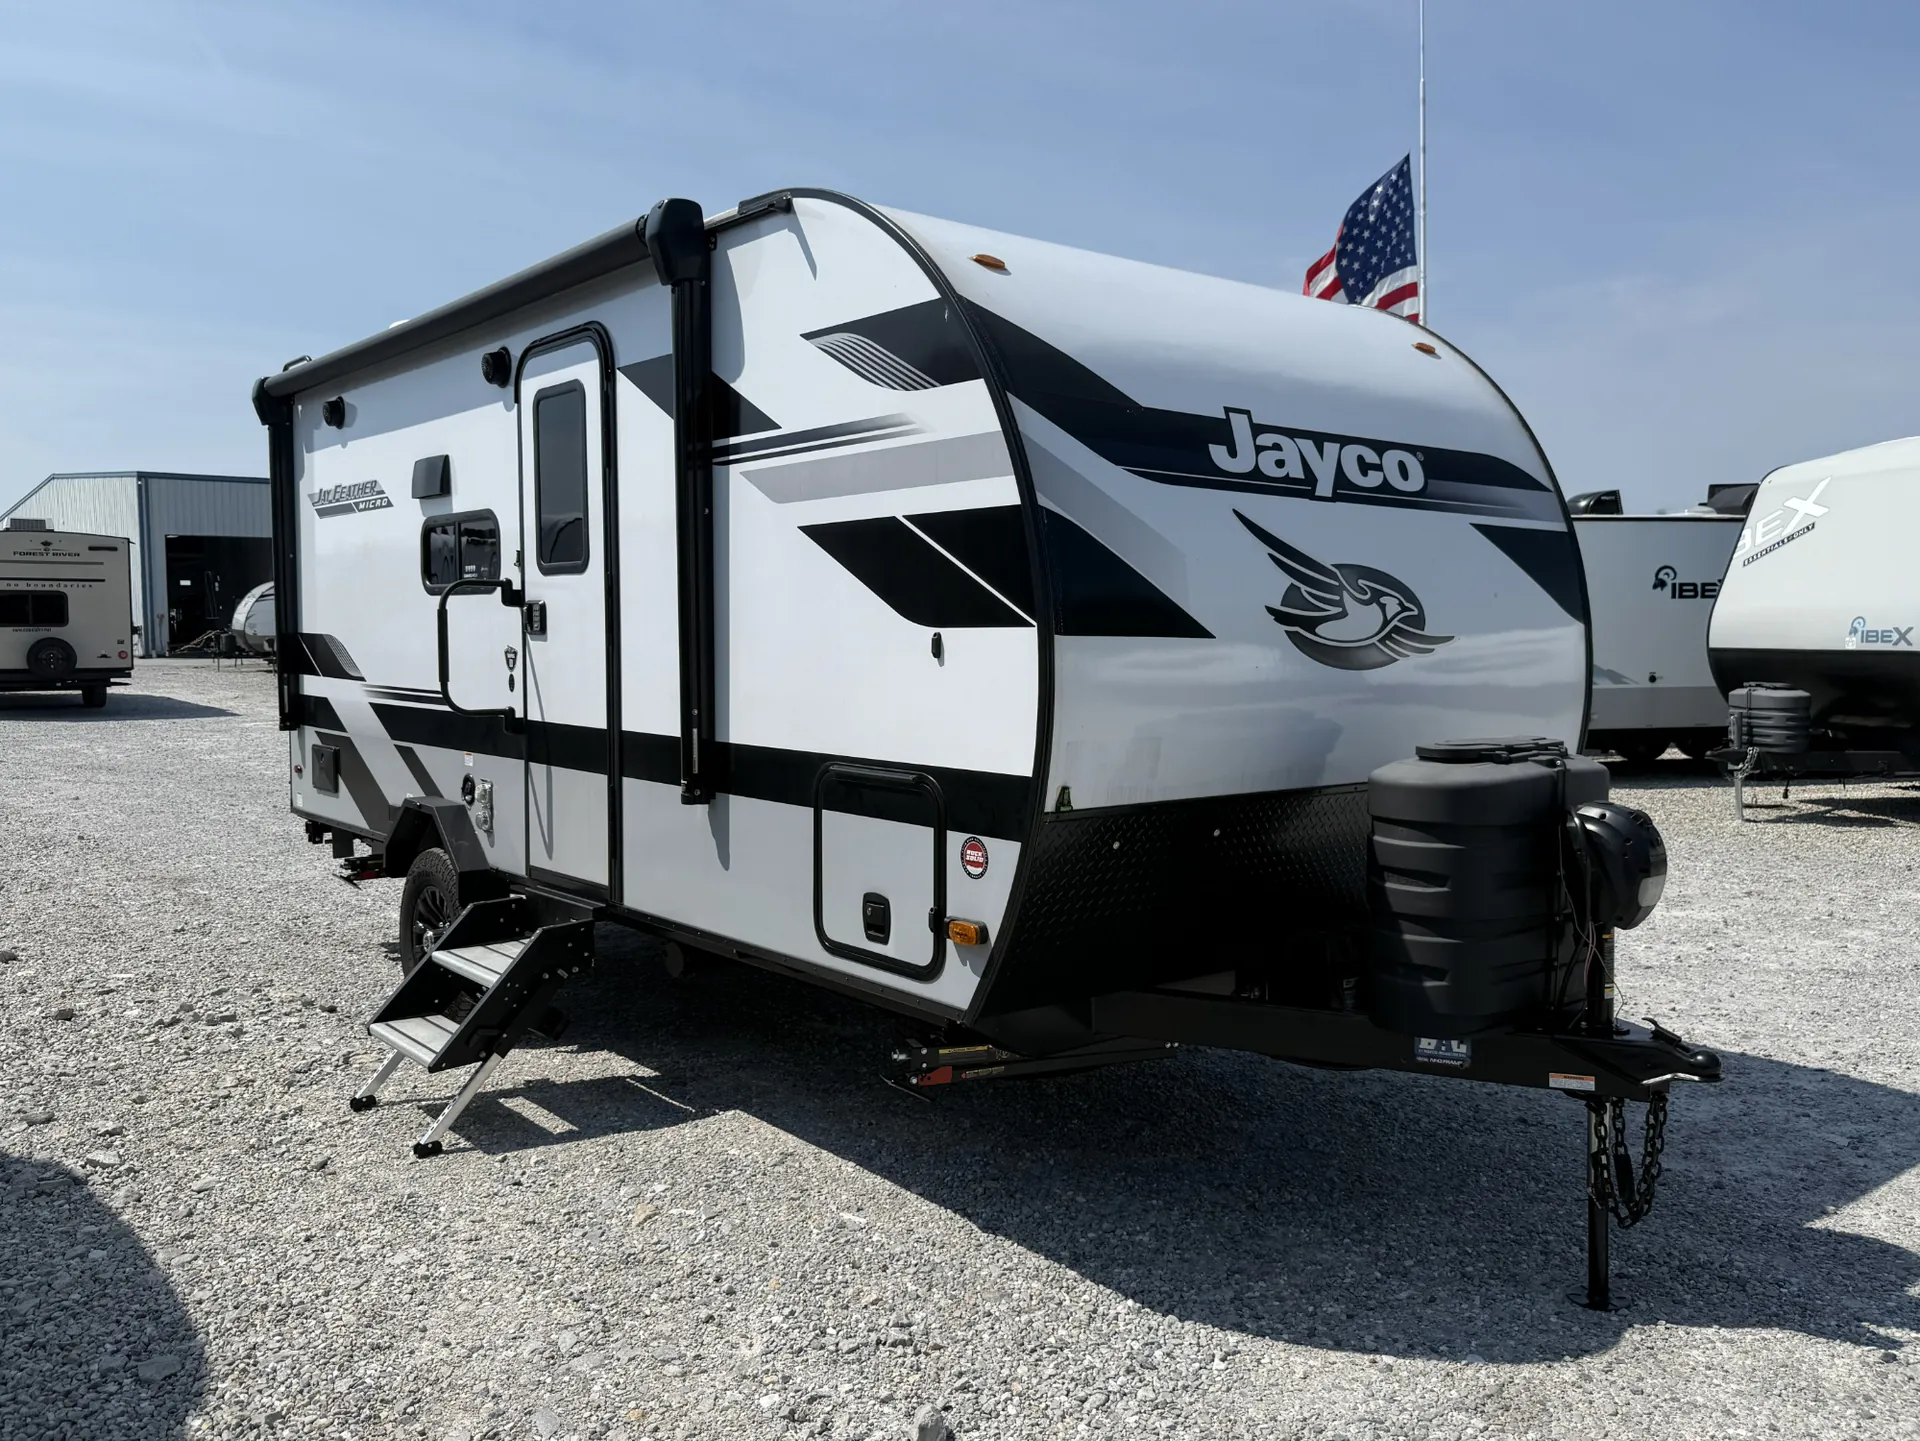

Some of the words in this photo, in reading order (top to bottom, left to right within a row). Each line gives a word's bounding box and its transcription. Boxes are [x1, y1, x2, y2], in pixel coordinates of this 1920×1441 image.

[358, 498, 388, 510] MICRO
[1671, 579, 1722, 599] IBE
[1861, 627, 1914, 646] IBEX
